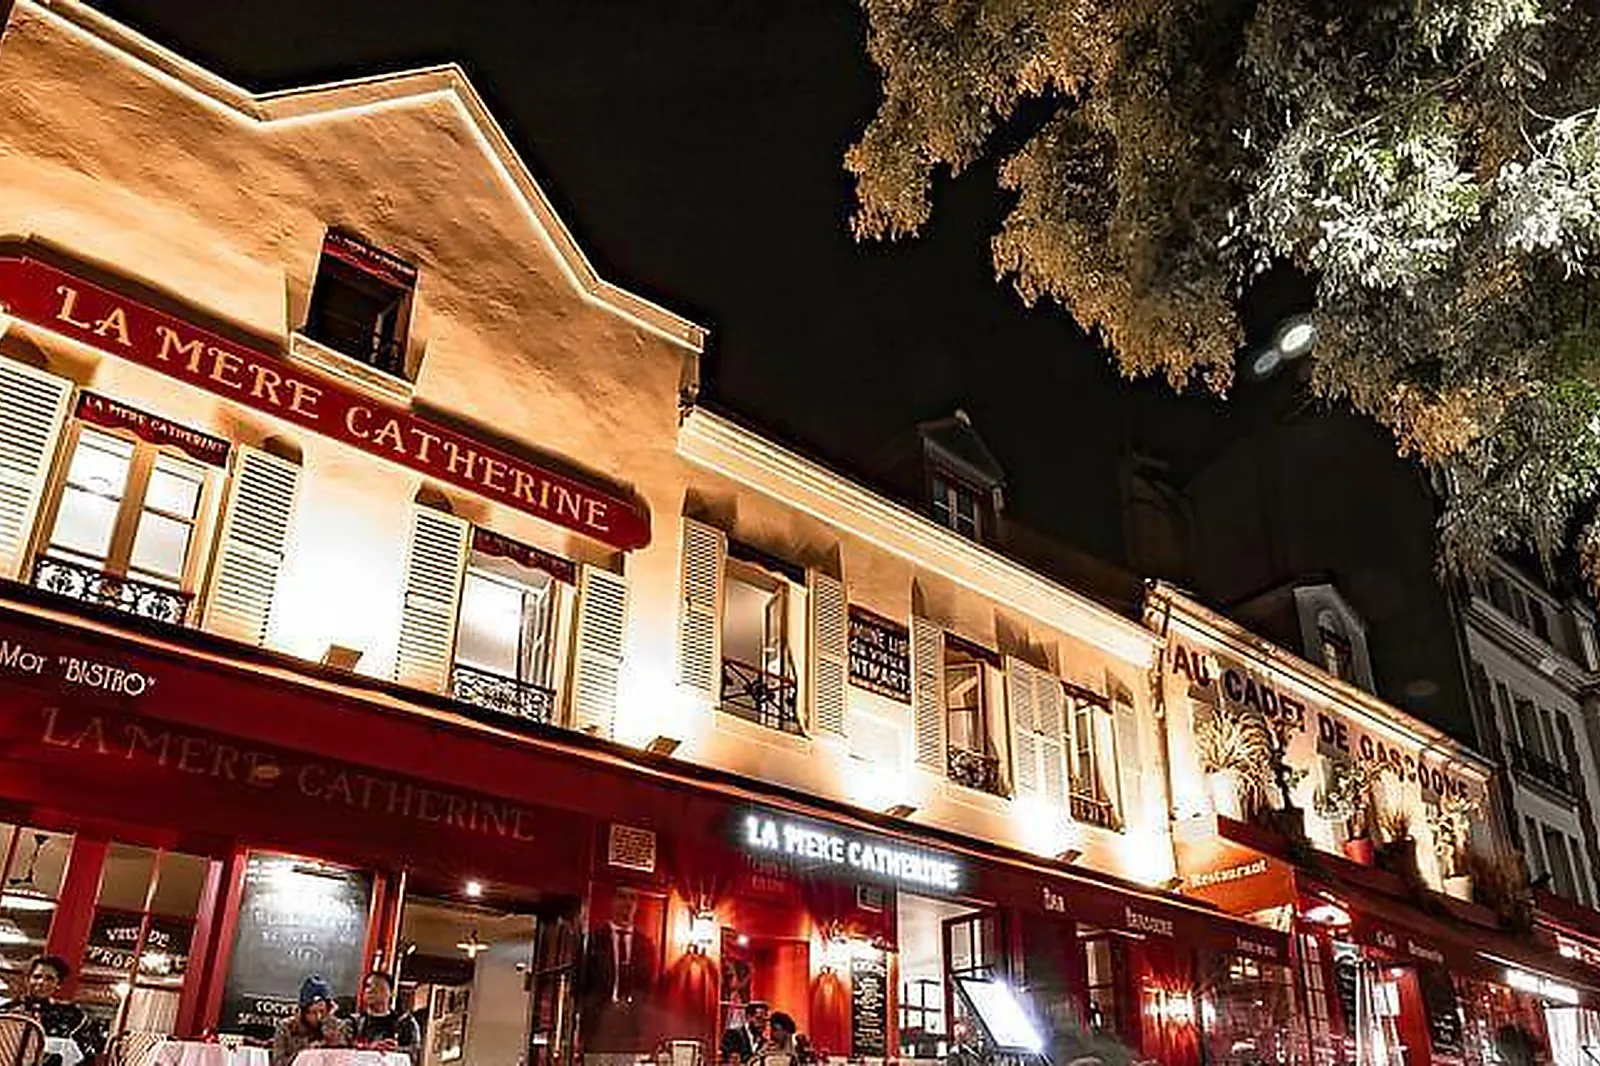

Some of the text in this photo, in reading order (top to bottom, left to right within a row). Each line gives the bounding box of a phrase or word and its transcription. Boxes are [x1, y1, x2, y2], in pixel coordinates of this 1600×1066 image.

[56, 284, 610, 532] LA MERE CATHERINE
[1171, 644, 1212, 687] AU
[1317, 712, 1350, 753] DE
[40, 706, 107, 755] LA
[297, 762, 537, 842] CATHERINE
[744, 814, 960, 891] LA MERE CATHERINE
